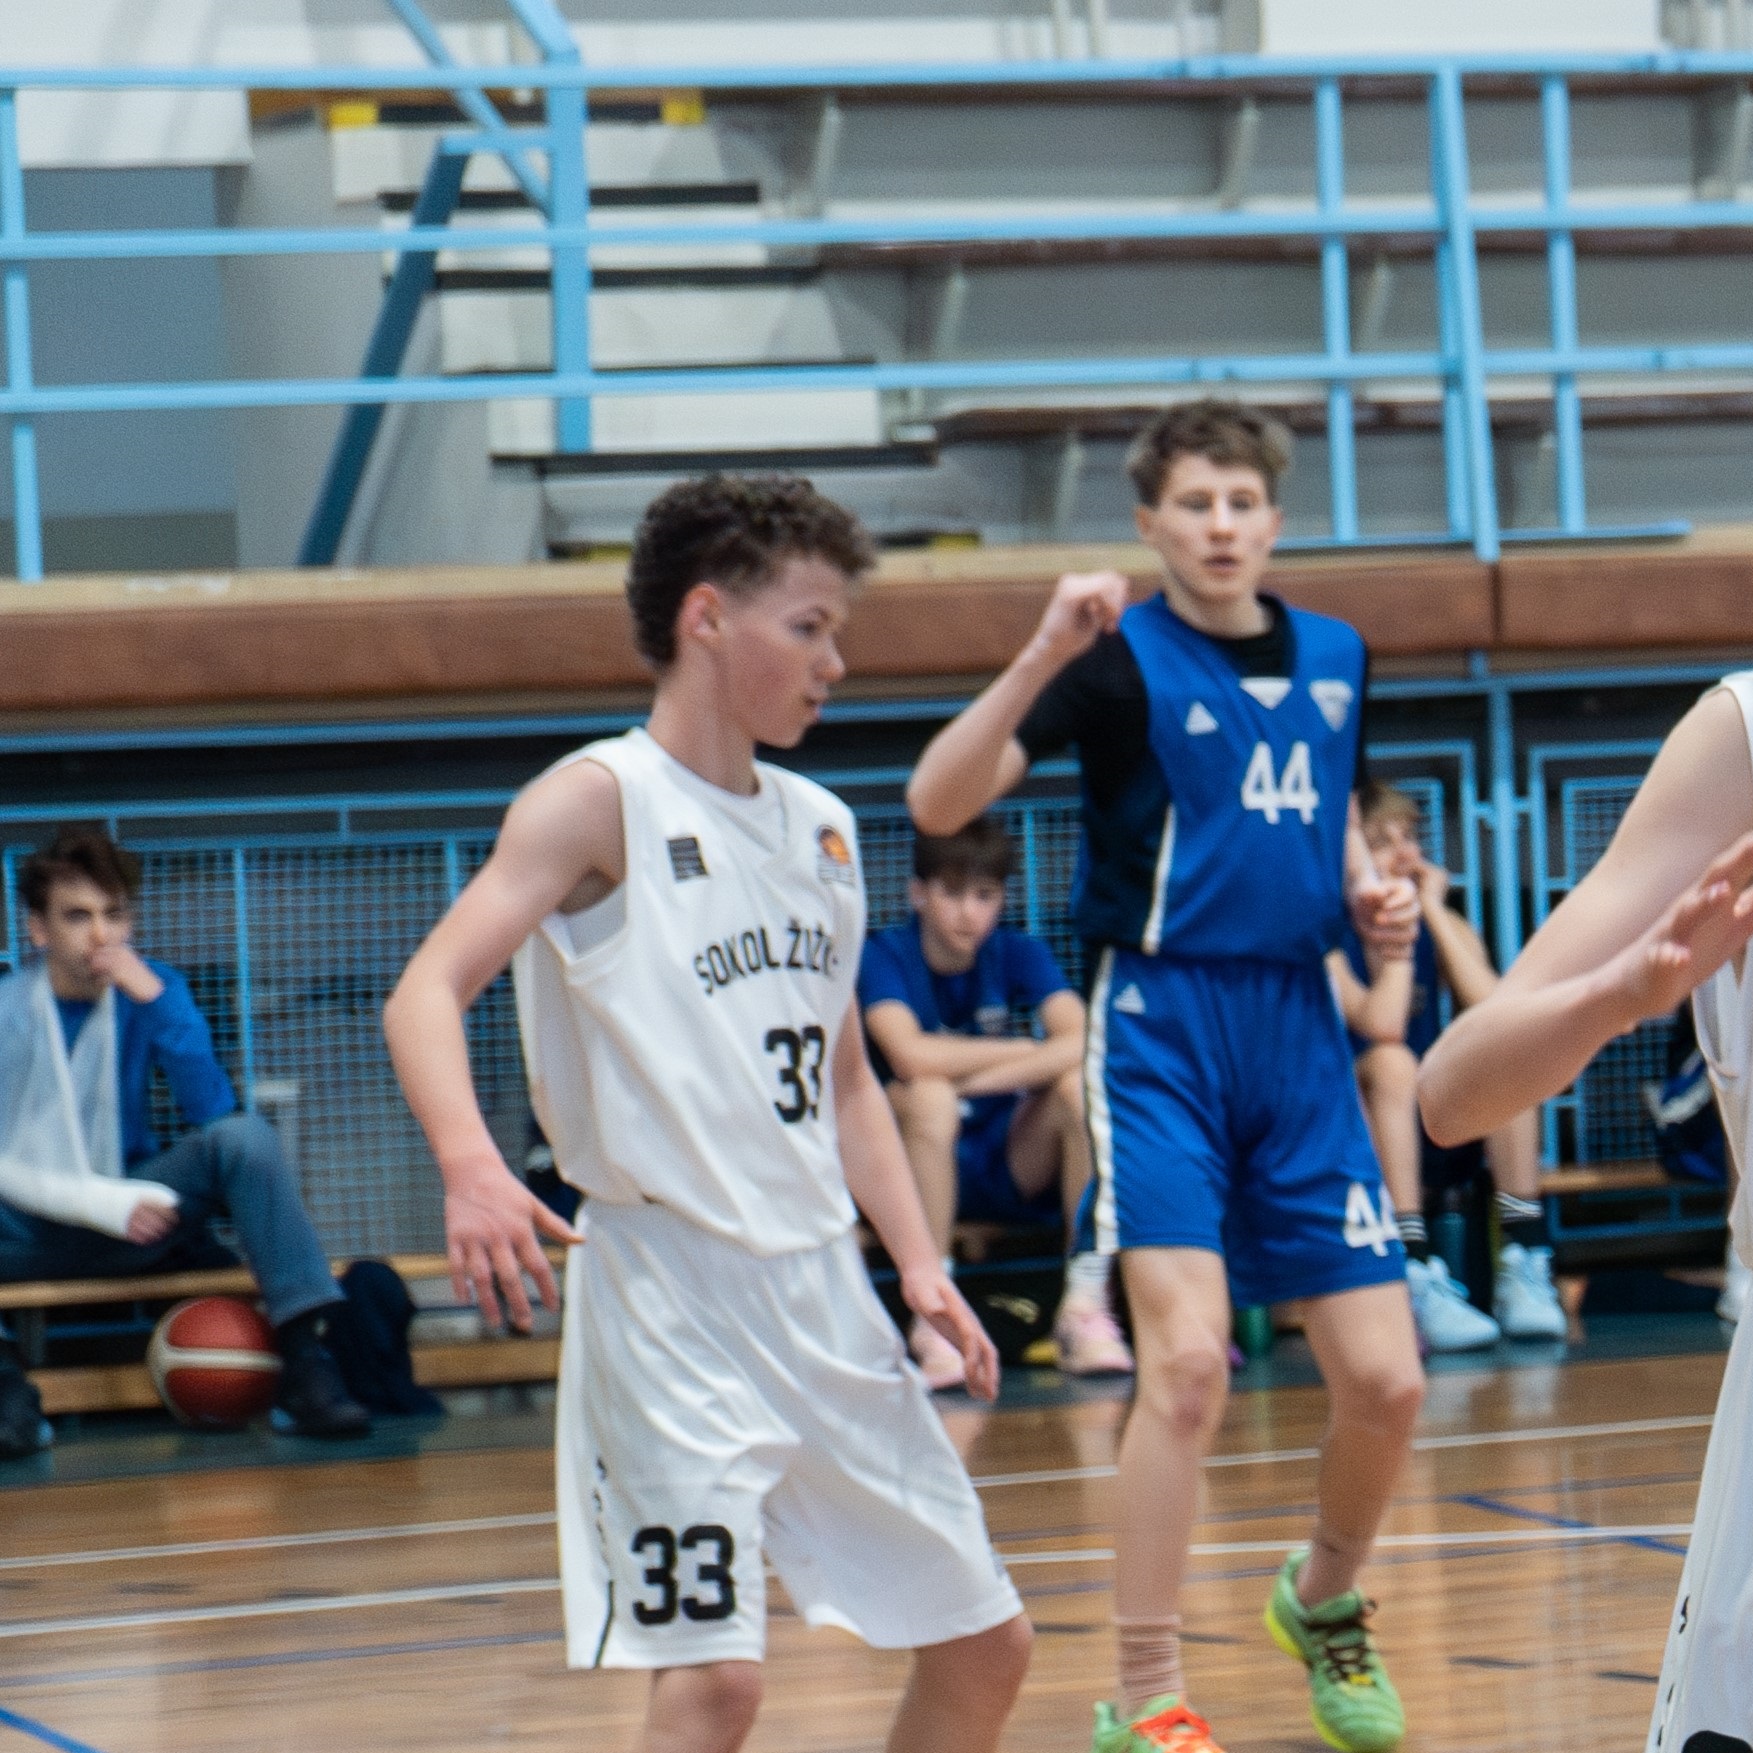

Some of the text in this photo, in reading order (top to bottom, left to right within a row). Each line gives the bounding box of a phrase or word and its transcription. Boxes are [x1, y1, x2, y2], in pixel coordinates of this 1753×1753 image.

[1241, 740, 1320, 825] 44
[694, 926, 780, 996] SOKOL
[764, 1025, 827, 1123] 33
[631, 1524, 736, 1626] 33
